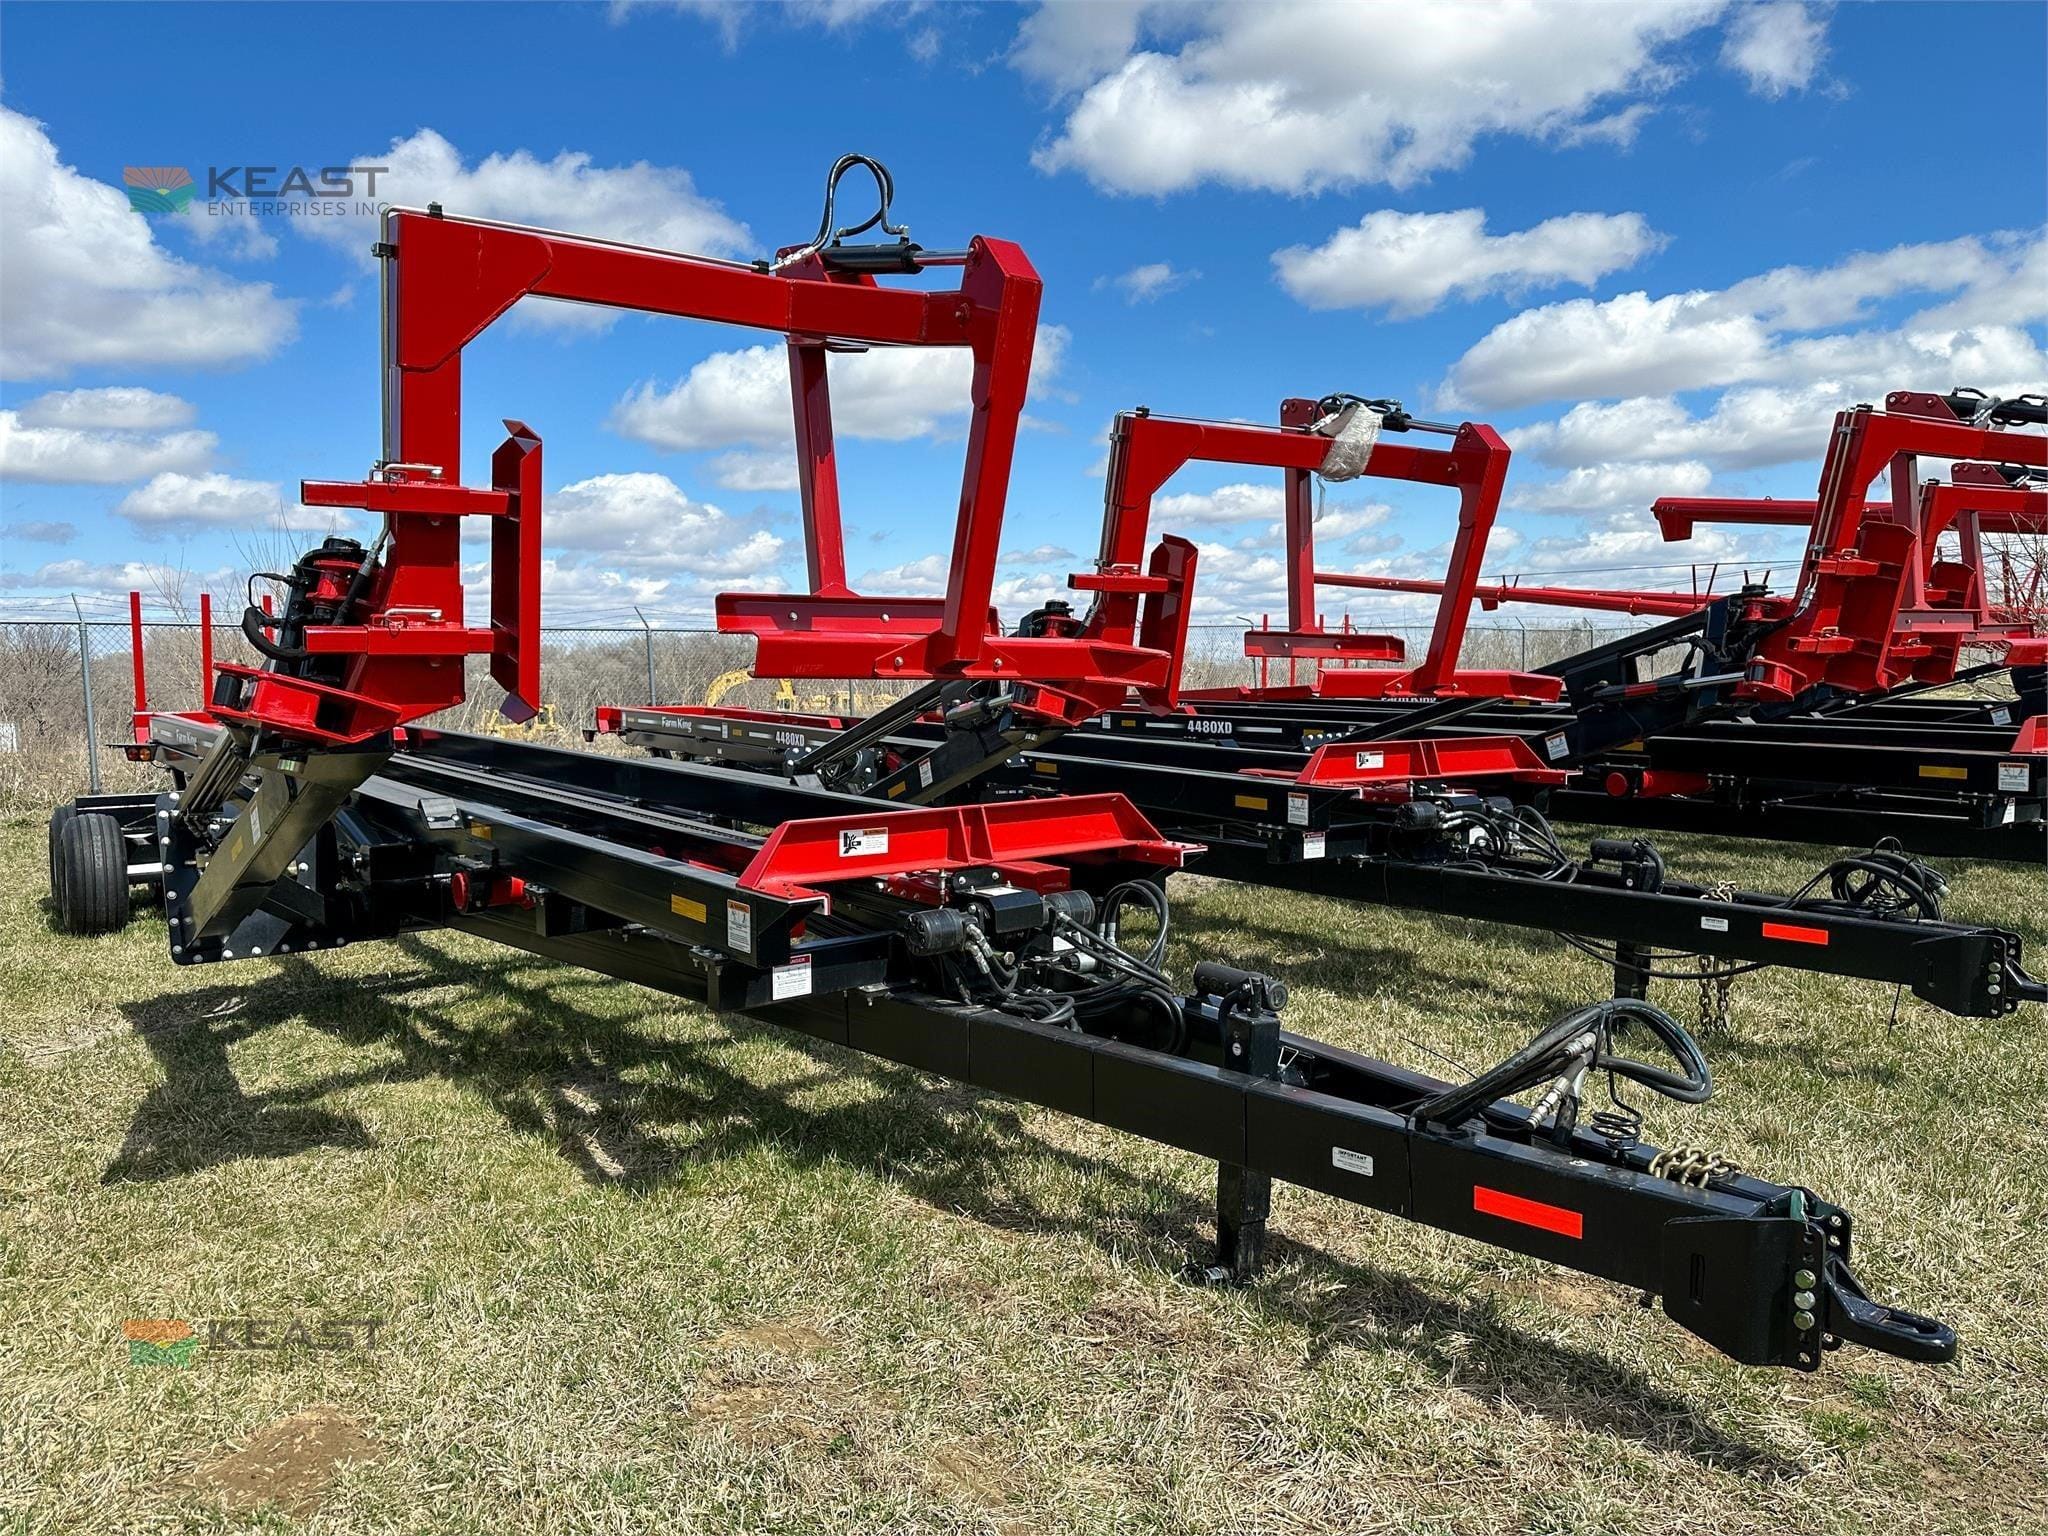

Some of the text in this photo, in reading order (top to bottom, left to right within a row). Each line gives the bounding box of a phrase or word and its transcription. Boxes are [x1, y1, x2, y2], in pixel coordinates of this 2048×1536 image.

[662, 716, 692, 733] Farm King
[1187, 720, 1233, 734] 4480XD
[775, 731, 805, 747] 4480XD
